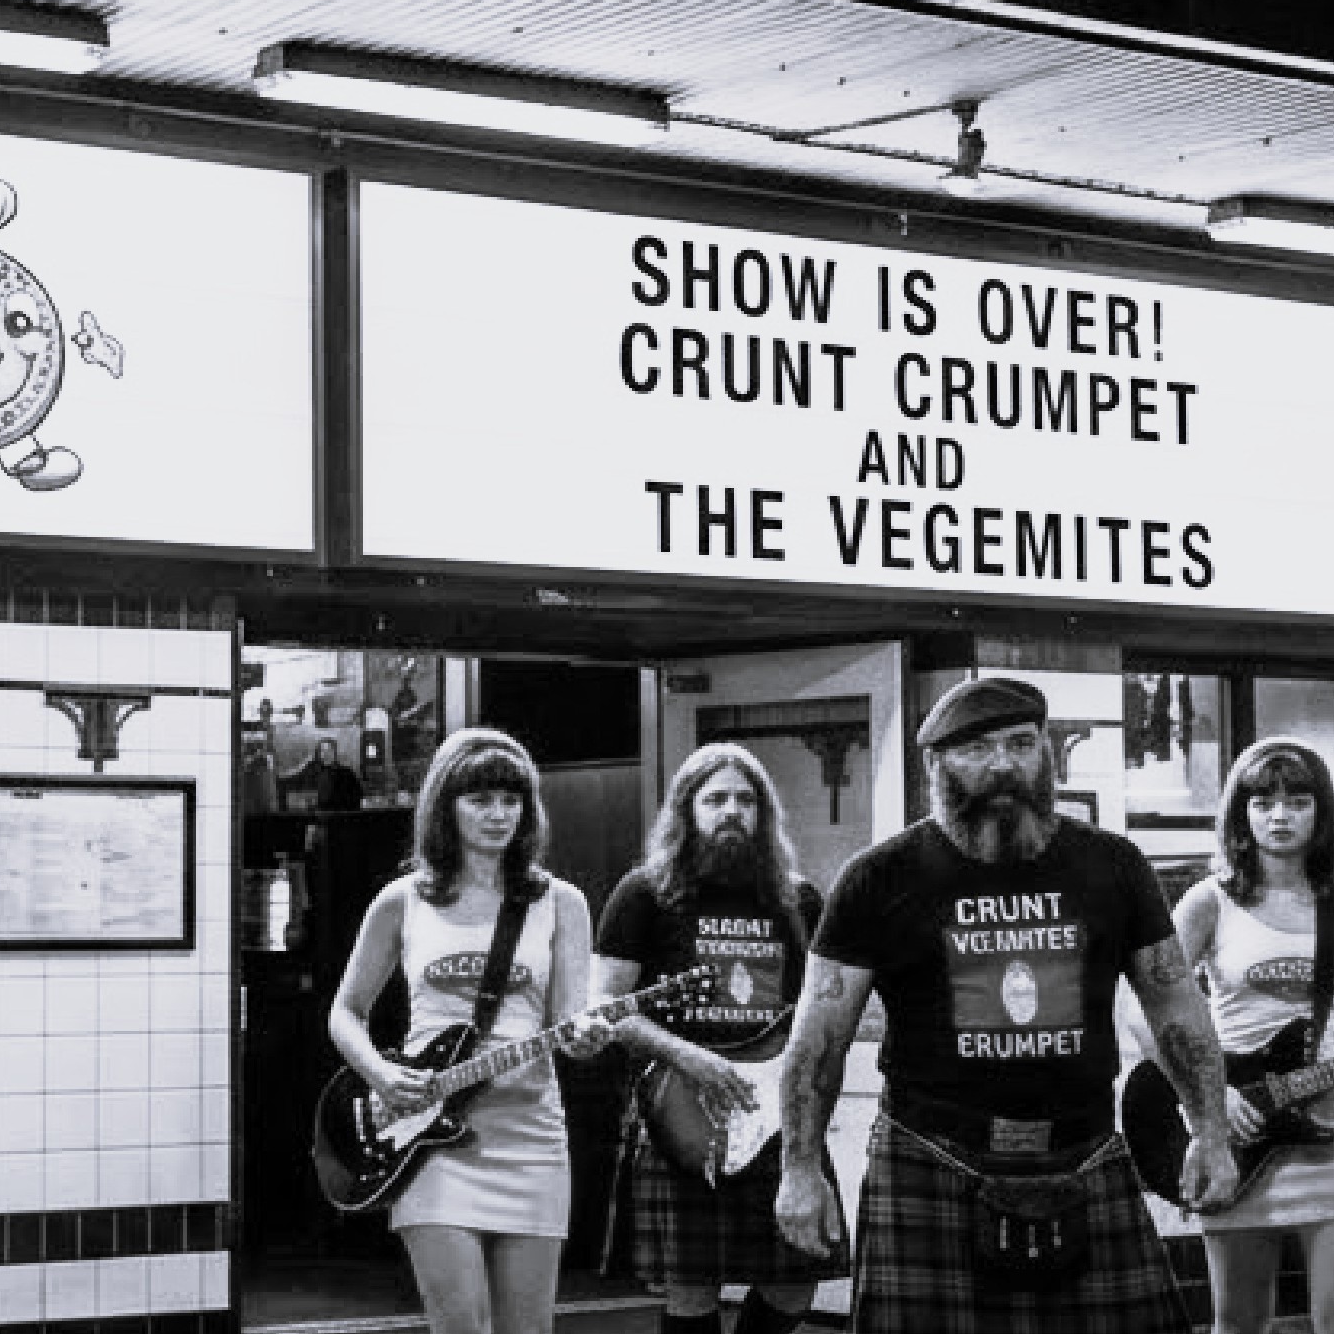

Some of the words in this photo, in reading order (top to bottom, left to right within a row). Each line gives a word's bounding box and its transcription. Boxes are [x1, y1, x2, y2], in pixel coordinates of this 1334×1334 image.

[632, 235, 837, 323] SHOW
[878, 267, 936, 335] IS
[978, 279, 1160, 358] OVER!
[622, 323, 856, 411] CRUNT
[898, 353, 1195, 444] CRUMPET
[859, 432, 962, 491] AND
[645, 482, 785, 561] THE
[830, 496, 1211, 587] VEGEMITES
[954, 892, 1062, 923] CRUNT
